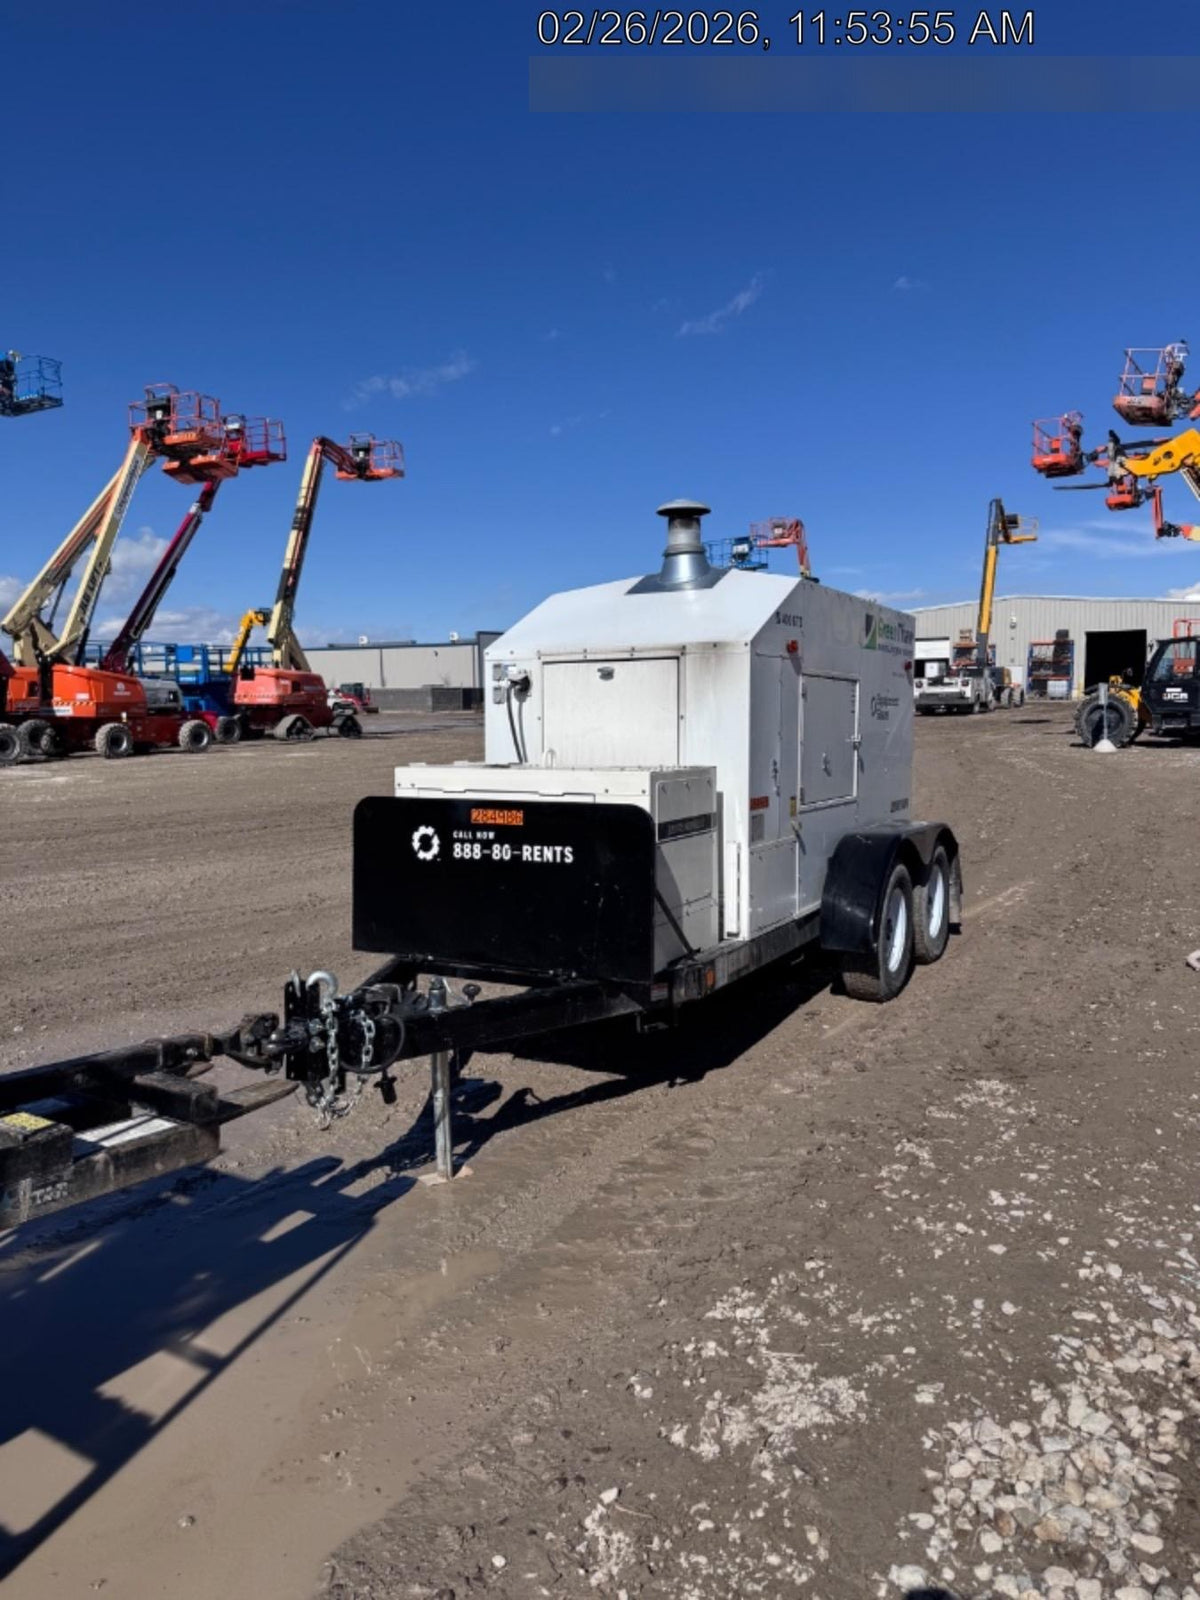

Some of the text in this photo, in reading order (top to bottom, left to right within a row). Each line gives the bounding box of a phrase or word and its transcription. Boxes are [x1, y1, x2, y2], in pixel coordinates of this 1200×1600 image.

[453, 830, 495, 840] CALL NOW
[453, 842, 574, 863] 888-80-RENTS
